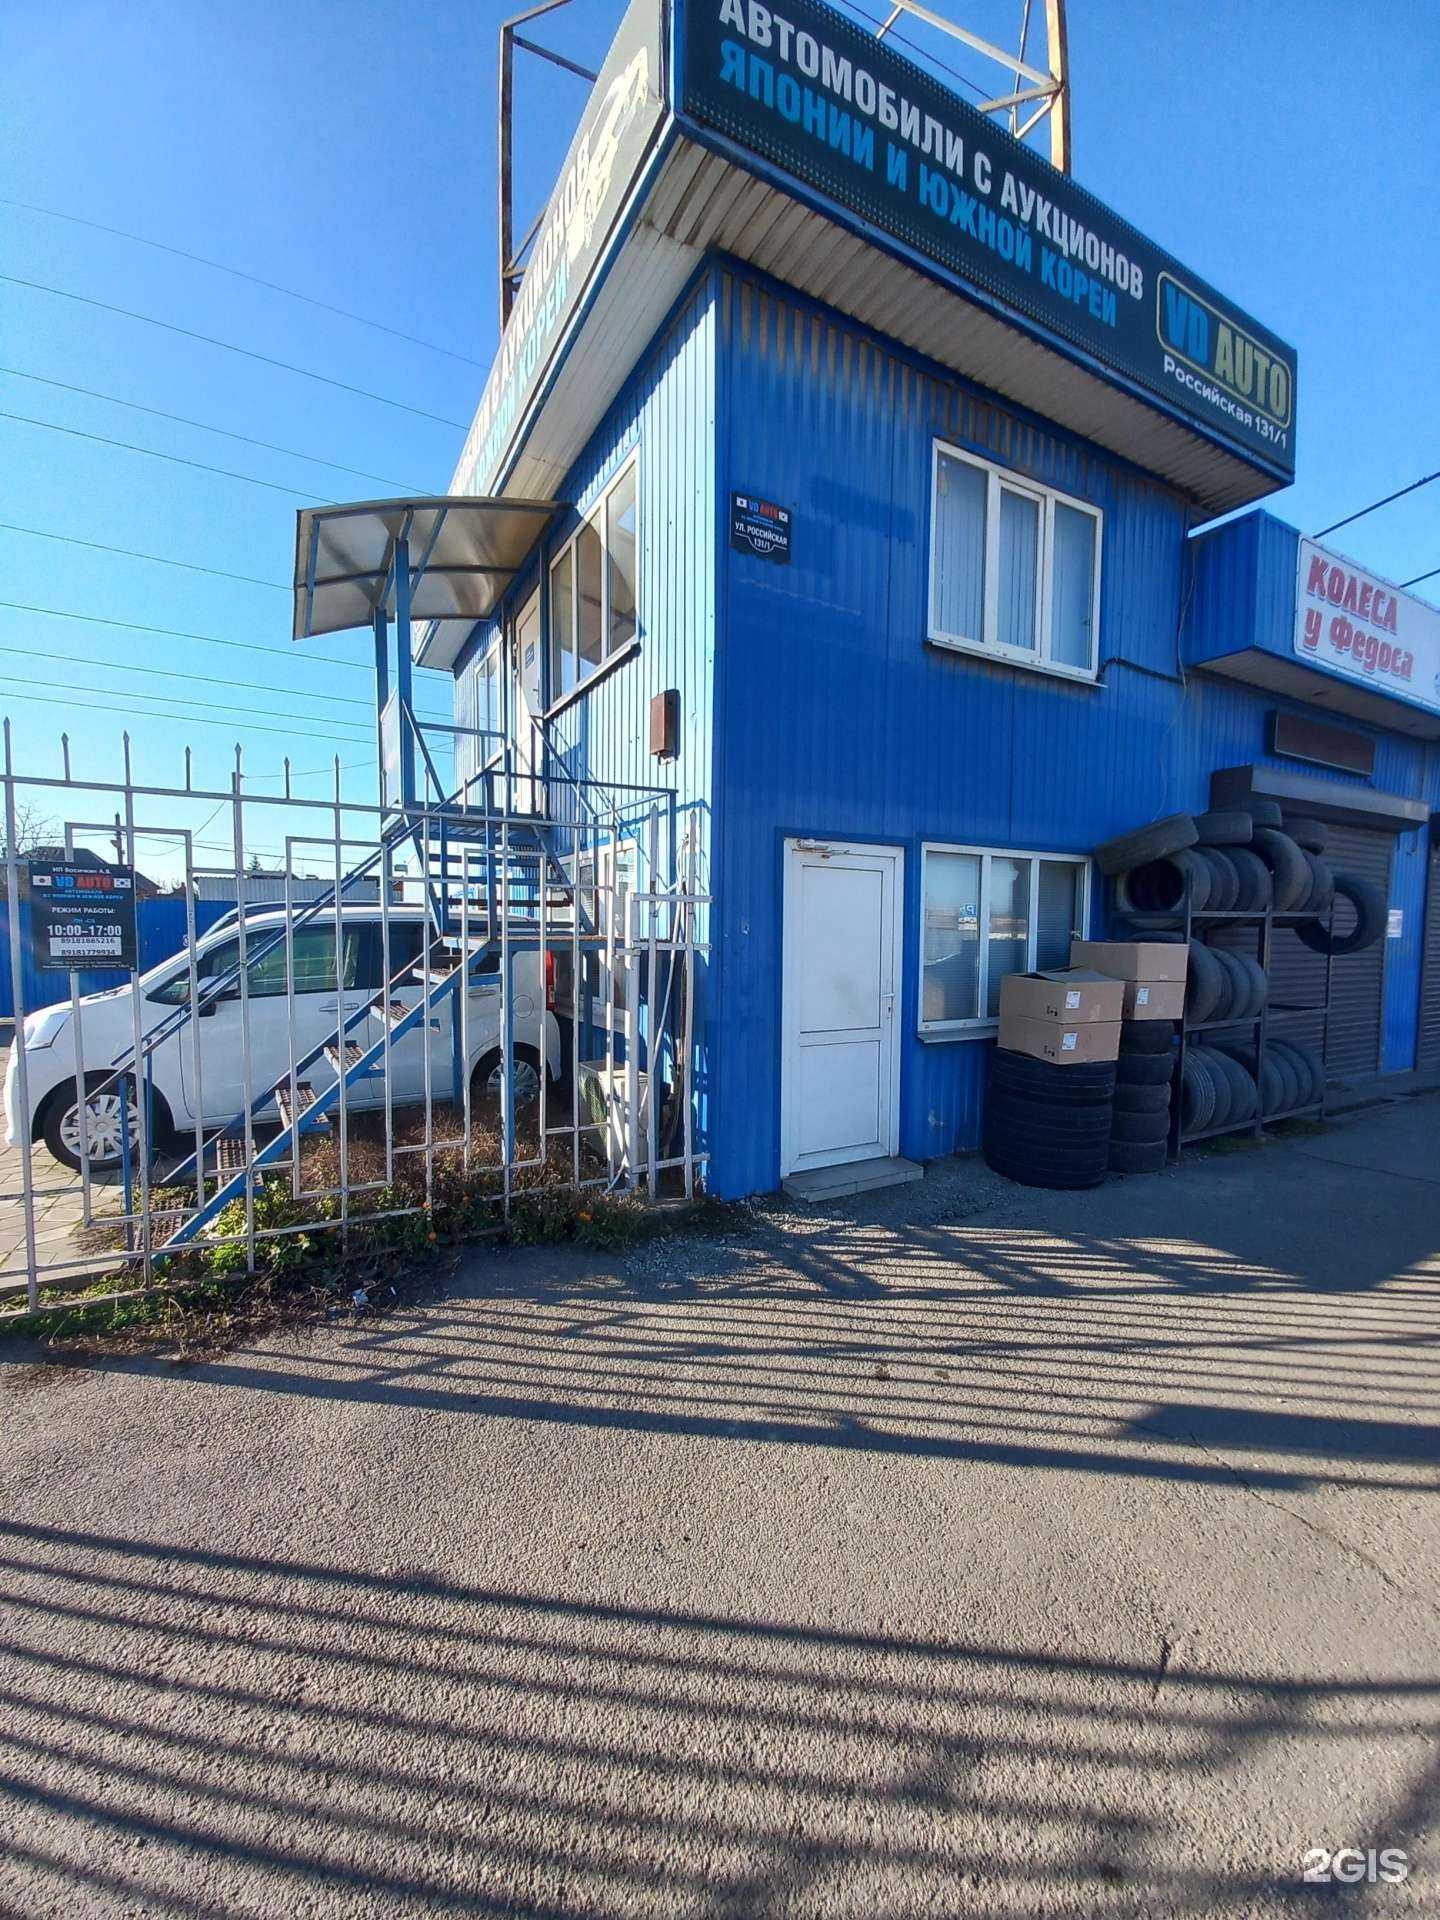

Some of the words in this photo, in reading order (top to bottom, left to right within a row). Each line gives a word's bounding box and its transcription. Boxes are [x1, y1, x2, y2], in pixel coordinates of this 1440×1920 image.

[718, 0, 964, 178] АВТОМОБИЛИ
[974, 150, 992, 195] С
[1000, 171, 1145, 301] АУКЦИОНОВ
[719, 39, 877, 172] ЯПОНИИ
[886, 141, 909, 193] И
[919, 163, 1033, 274] ЮЖНОЙ
[1041, 244, 1117, 328] КОРЕИ
[1163, 282, 1209, 365] VD
[1214, 321, 1289, 419] AUTO
[1163, 354, 1252, 429] Российская
[1254, 416, 1288, 449] 131/1
[1308, 555, 1398, 632] КОЛЕСА
[1330, 615, 1414, 680] Федоса
[51, 906, 82, 914] РЕЖИМ
[55, 876, 74, 888] VD
[76, 876, 112, 889] AUTO
